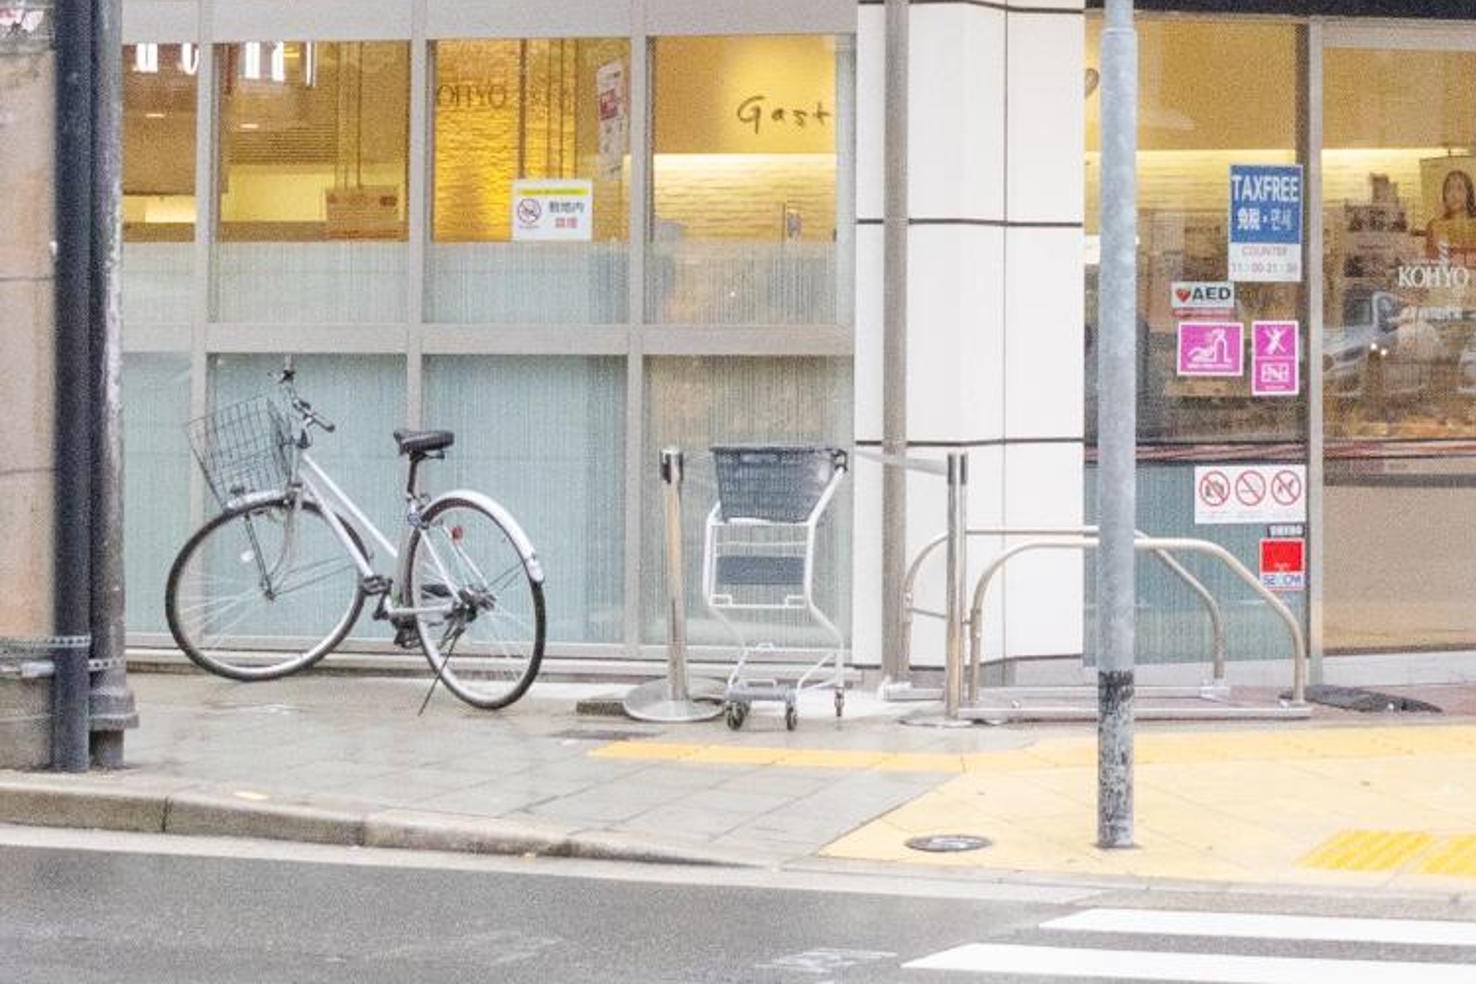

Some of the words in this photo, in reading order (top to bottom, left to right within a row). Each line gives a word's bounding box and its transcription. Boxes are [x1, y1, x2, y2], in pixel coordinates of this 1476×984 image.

[1231, 174, 1300, 203] TAXFREE
[1399, 266, 1469, 288] KOHYO
[1192, 287, 1231, 300] AED
